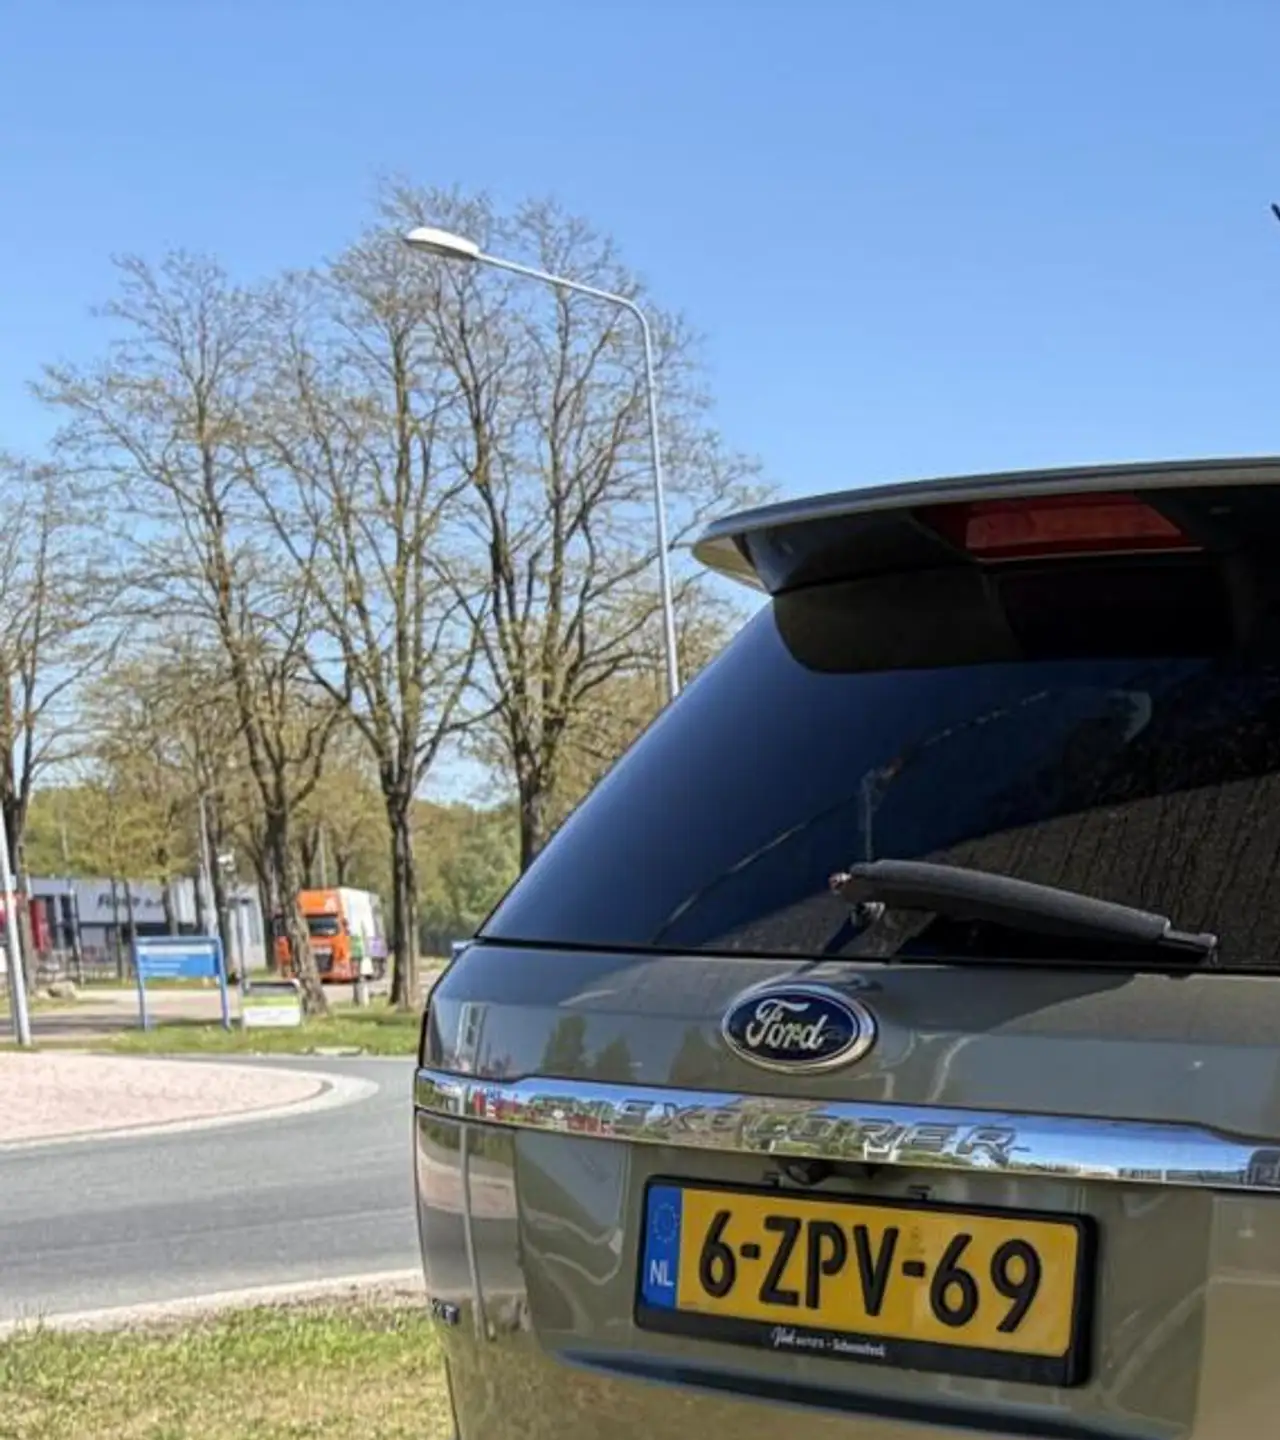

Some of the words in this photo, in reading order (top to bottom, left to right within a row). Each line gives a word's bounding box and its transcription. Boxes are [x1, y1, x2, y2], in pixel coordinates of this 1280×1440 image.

[746, 998, 829, 1050] Ford
[649, 1259, 674, 1287] NL
[699, 1209, 1042, 1333] 6-ZPV-69
